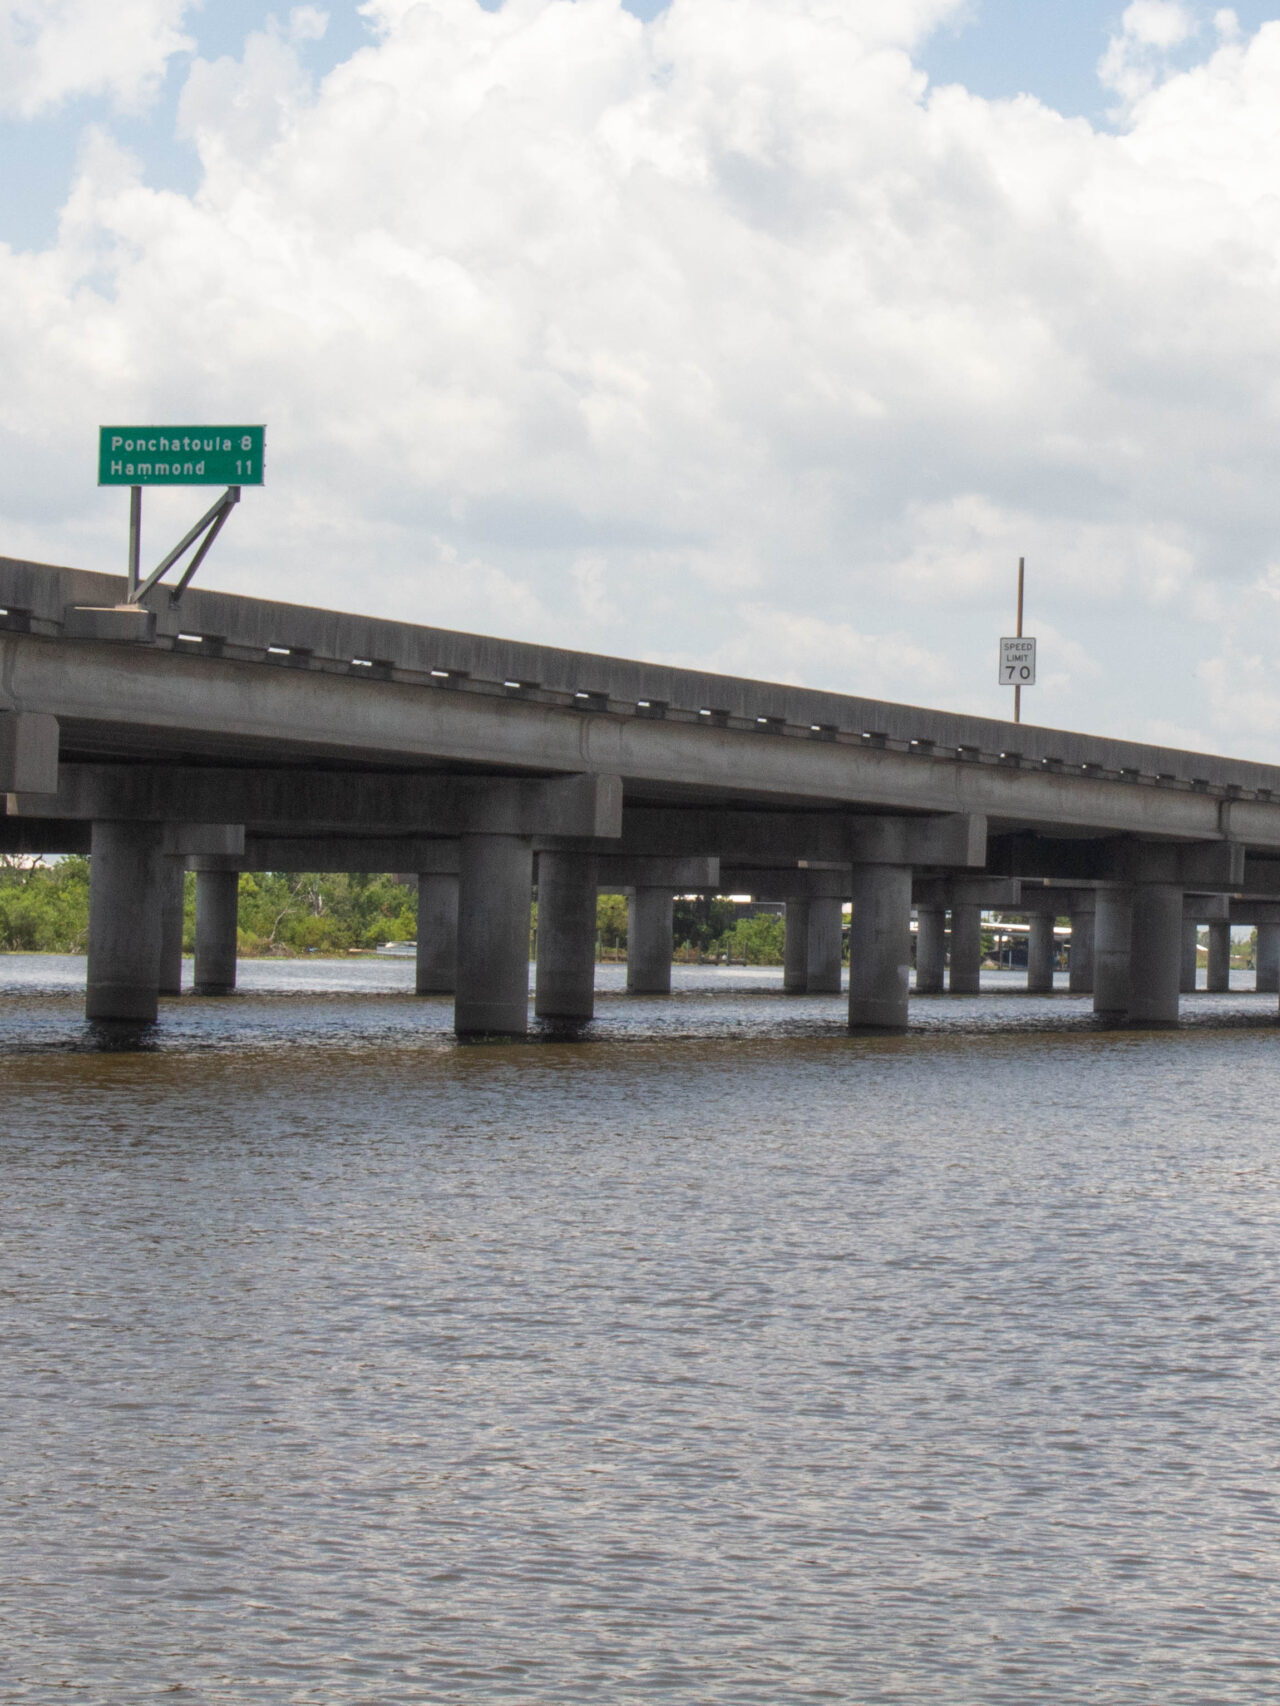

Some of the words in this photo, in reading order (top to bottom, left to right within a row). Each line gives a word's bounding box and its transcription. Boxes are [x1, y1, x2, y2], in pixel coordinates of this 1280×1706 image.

[111, 436, 232, 451] Ponchatoula
[240, 435, 252, 451] 8
[110, 460, 205, 475] Hammond
[236, 460, 252, 475] 11
[1004, 643, 1032, 651] SPEED
[1006, 654, 1028, 662] LIMIT
[1005, 666, 1030, 680] 70
